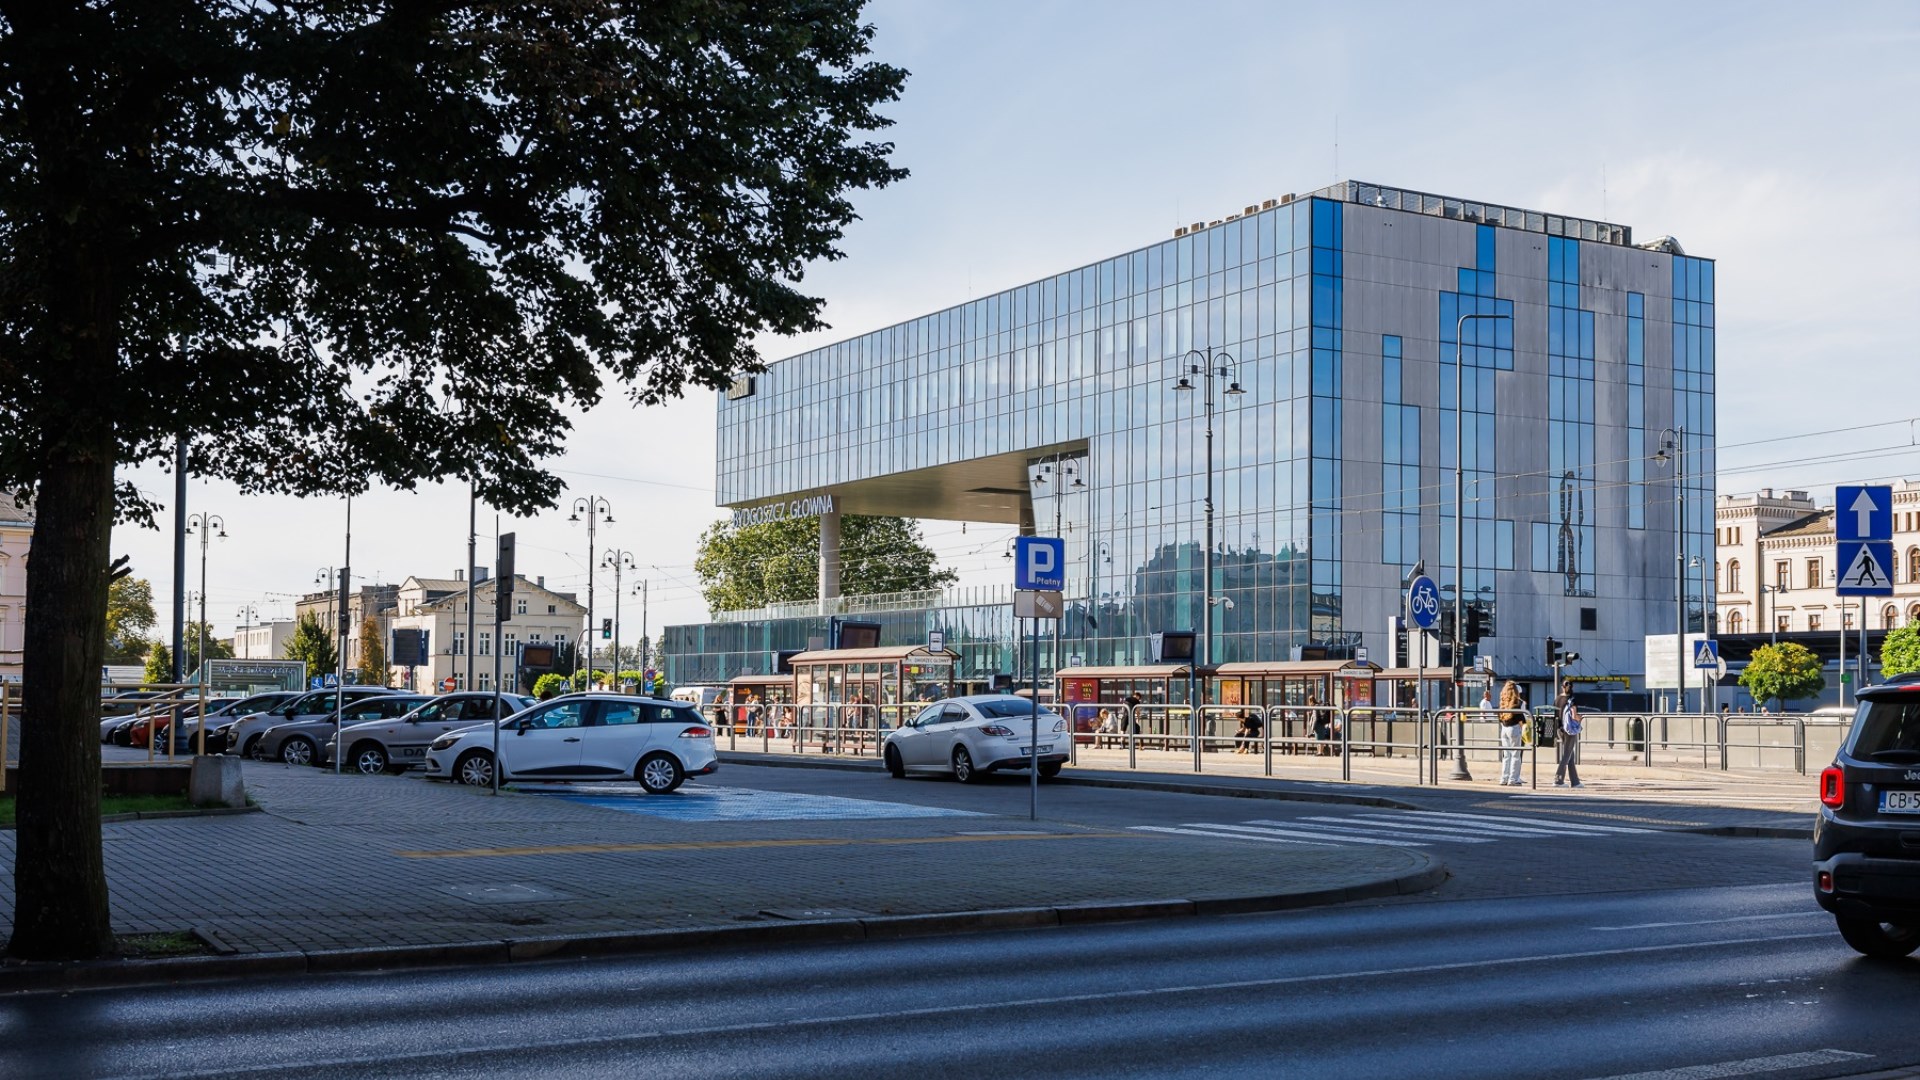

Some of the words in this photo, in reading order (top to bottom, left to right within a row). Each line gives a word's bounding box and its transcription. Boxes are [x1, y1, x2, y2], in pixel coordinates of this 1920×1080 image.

[733, 502, 786, 528] BYDGOSZCZ
[1028, 543, 1054, 583] P
[1889, 793, 1907, 809] CB
